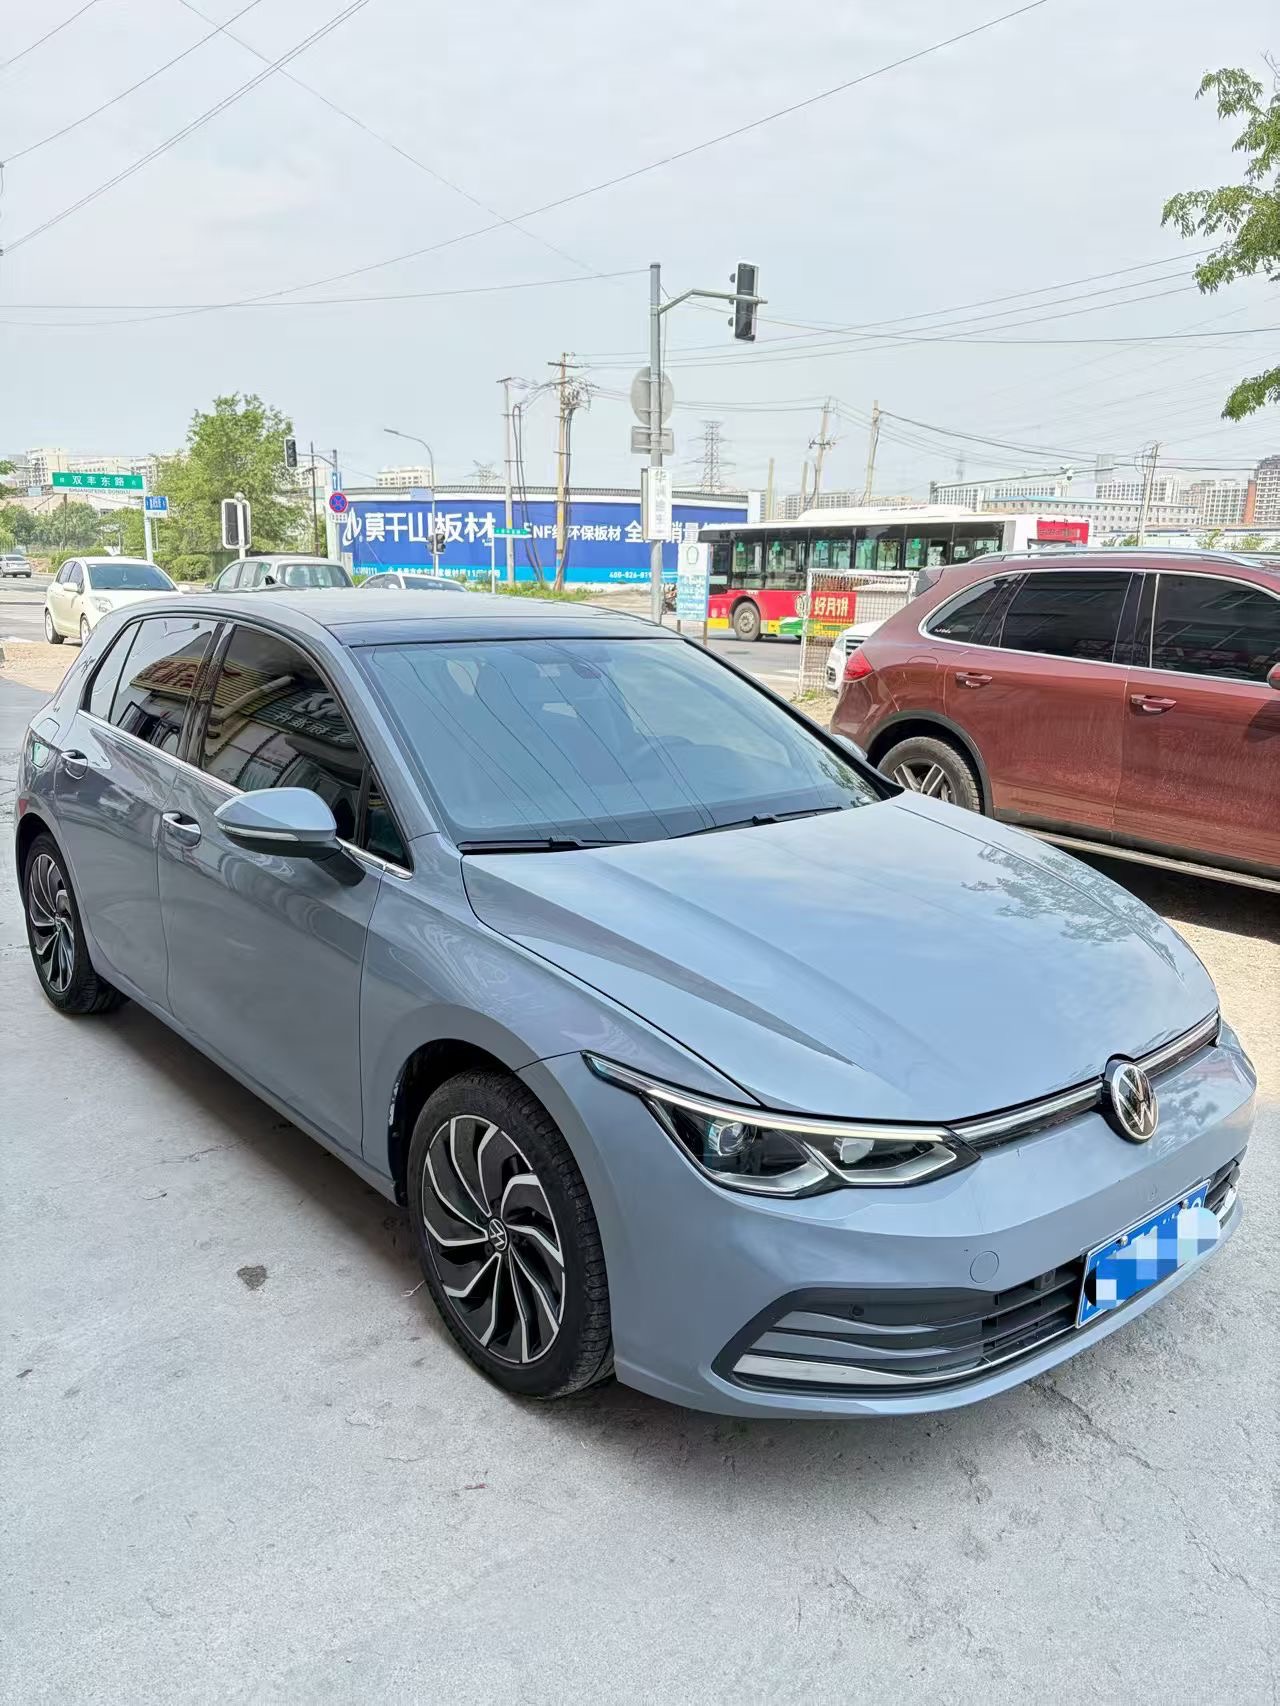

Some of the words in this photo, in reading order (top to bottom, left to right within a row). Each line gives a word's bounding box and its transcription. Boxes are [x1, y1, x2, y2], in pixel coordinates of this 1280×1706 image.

[72, 475, 124, 487] 双丰东路
[364, 511, 497, 543] 莫干山板材
